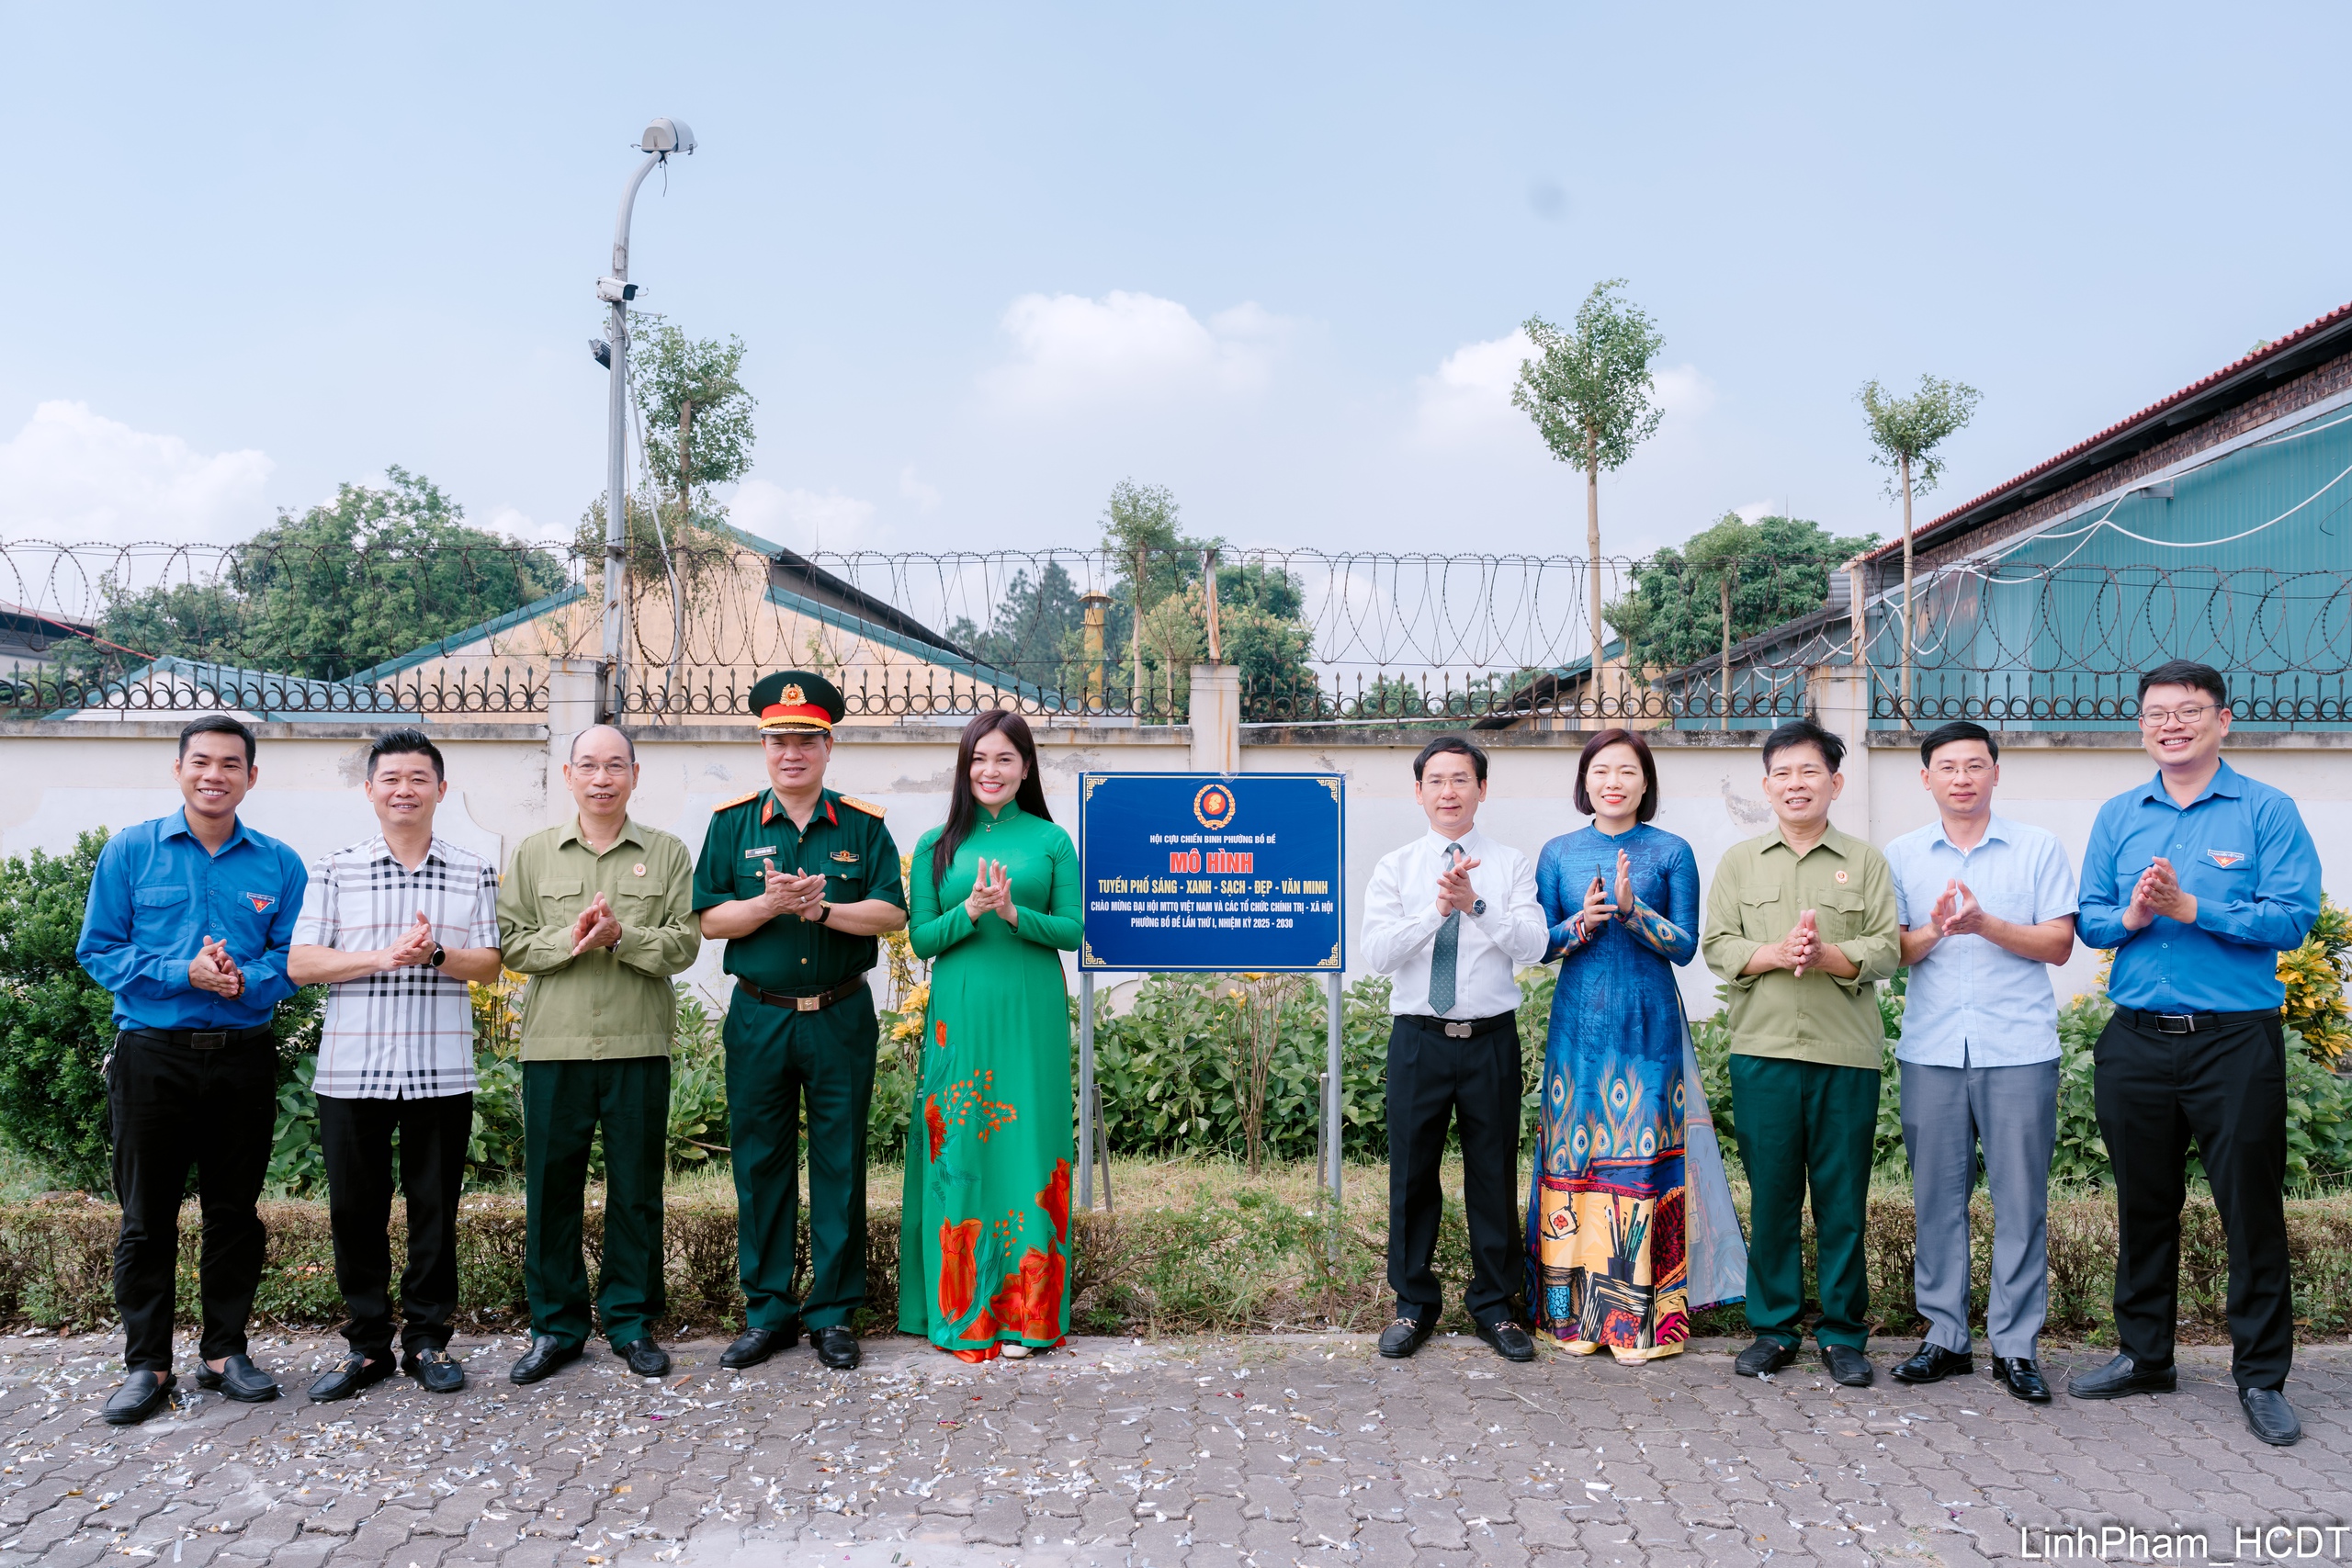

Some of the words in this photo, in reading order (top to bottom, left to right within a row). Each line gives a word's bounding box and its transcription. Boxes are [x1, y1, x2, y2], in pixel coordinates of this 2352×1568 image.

[1149, 833, 1162, 845] HỘI
[1164, 835, 1179, 845] CỰU
[1181, 833, 1203, 843] CHIẾN
[1204, 835, 1222, 843] BINH
[1224, 834, 1253, 844] PHƯỜNG
[1170, 848, 1201, 874] MÔ
[1206, 848, 1253, 874] HÌNH
[1098, 874, 1128, 894] TUYẾN
[1130, 874, 1149, 894] PHỐ
[1151, 876, 1178, 894] SÁNG
[1186, 880, 1212, 894] XANH
[1220, 880, 1246, 897] SẠCH
[1254, 880, 1272, 897] ĐẸP
[1282, 877, 1301, 894] VĂN
[1303, 880, 1329, 894] MINH
[1091, 899, 1110, 911] CHÀO
[1111, 899, 1132, 911] MỪNG
[1133, 901, 1146, 913] ĐẠI
[1147, 899, 1159, 913] HỘI
[1159, 901, 1179, 912] MTTQ
[1180, 899, 1194, 913] VIỆT
[1196, 902, 1213, 911] NAM
[1214, 900, 1223, 911] VÀ
[1225, 900, 1238, 912] CÁC
[1250, 900, 1269, 912] CHỨC
[1270, 900, 1292, 912] CHÍNH
[1294, 902, 1305, 914] TRỊ
[1310, 901, 1320, 912] XÃ
[1321, 901, 1333, 914] HỘI
[1131, 916, 1159, 928] PHƯỜNG
[1197, 916, 1212, 928] THỨ
[1218, 916, 1241, 930] NHIỆM
[1253, 919, 1270, 928] 2025
[1276, 919, 1294, 928] 2030
